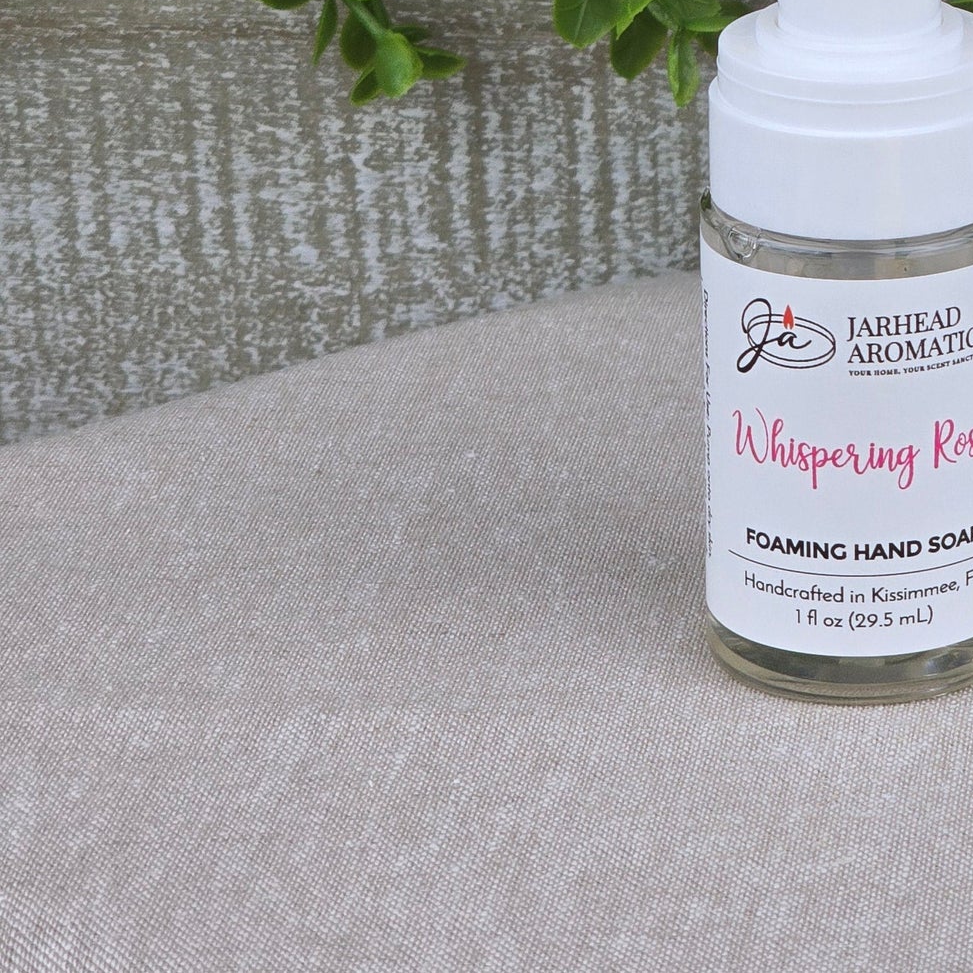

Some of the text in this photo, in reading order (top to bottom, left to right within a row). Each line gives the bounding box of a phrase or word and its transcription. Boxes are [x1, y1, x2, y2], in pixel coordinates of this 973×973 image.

[846, 306, 961, 342] JARHEAD
[903, 365, 924, 374] YOUR
[926, 360, 951, 371] SCENT
[732, 408, 920, 490] Whispering
[746, 527, 847, 560] FOAMING
[854, 541, 922, 560] HAND
[744, 570, 845, 603] Handcrafted
[850, 590, 865, 604] in
[871, 579, 960, 603] Kissimmee,
[795, 604, 934, 631] 1 fl oz (29.5 mL)
